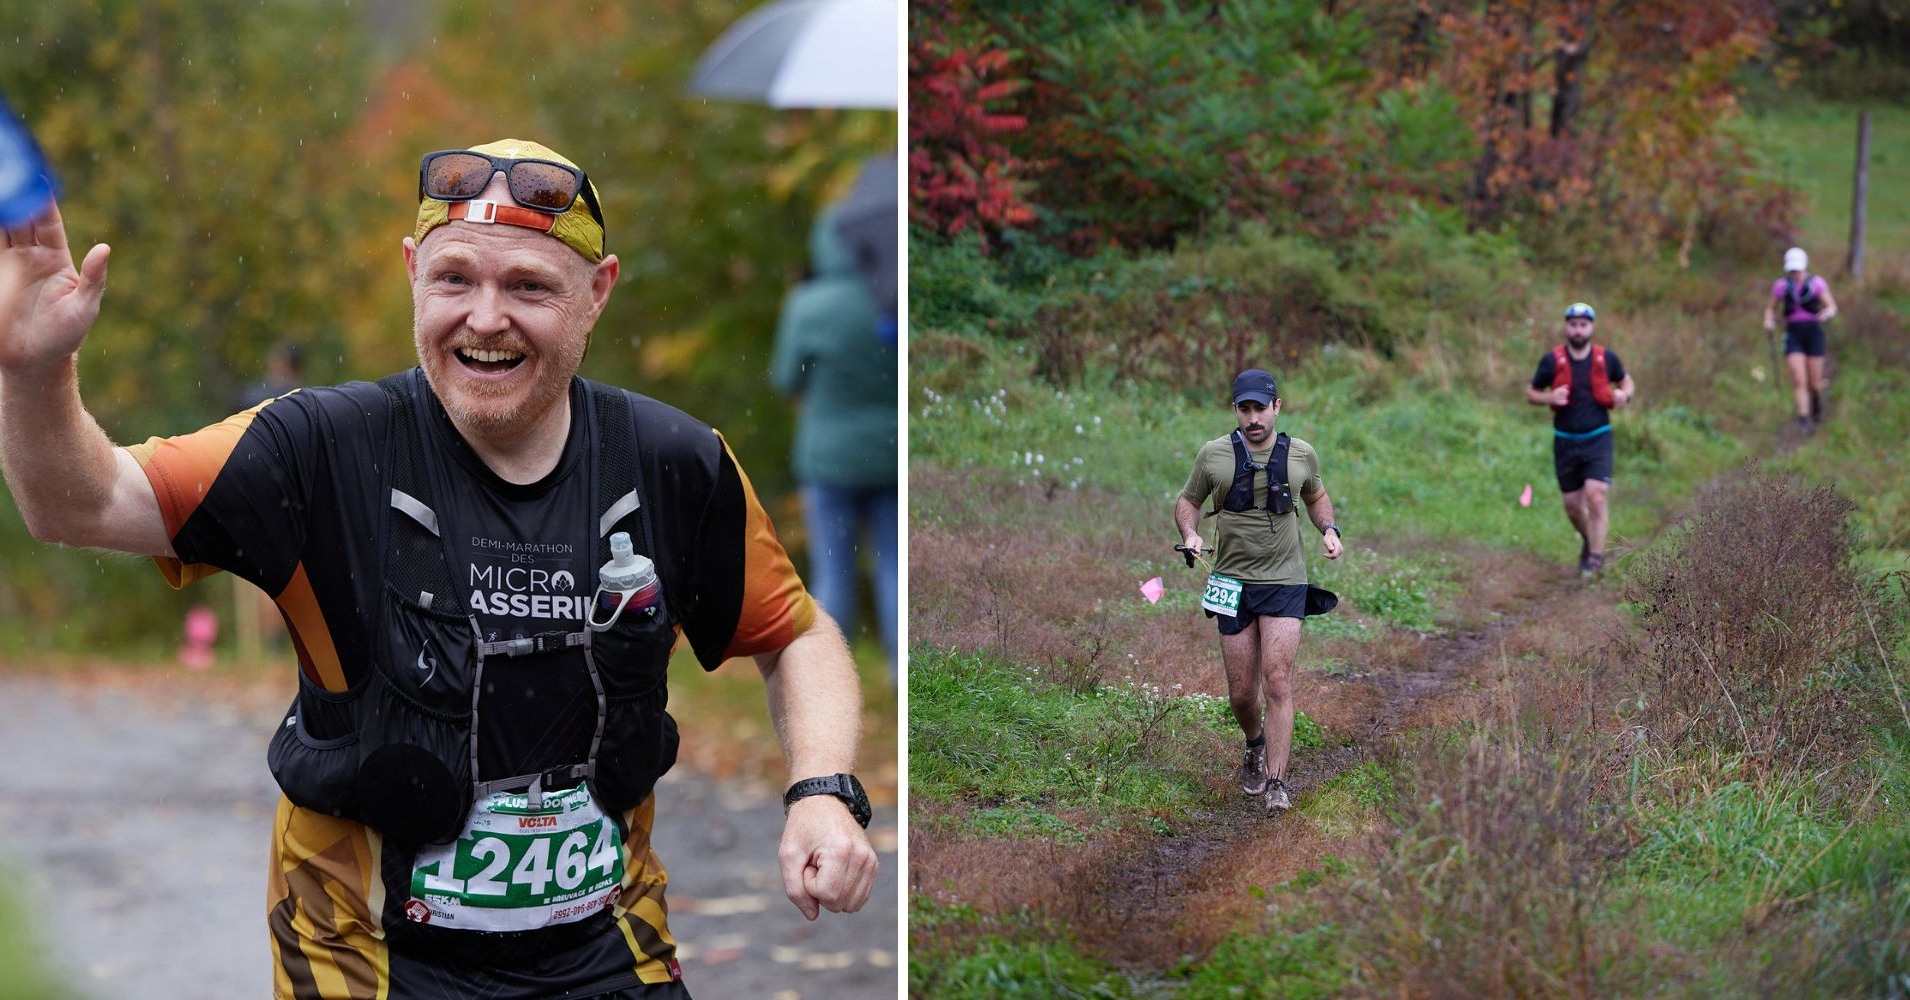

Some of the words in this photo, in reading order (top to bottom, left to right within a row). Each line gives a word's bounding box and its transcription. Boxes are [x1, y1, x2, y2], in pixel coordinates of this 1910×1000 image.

[471, 536, 573, 553] DEMI-MARATHON
[511, 554, 535, 564] DES
[470, 563, 575, 593] MICRO
[497, 796, 528, 809] PLUS
[518, 816, 558, 828] VOLTA
[424, 818, 618, 896] 12464
[429, 909, 455, 920] RISTIAN
